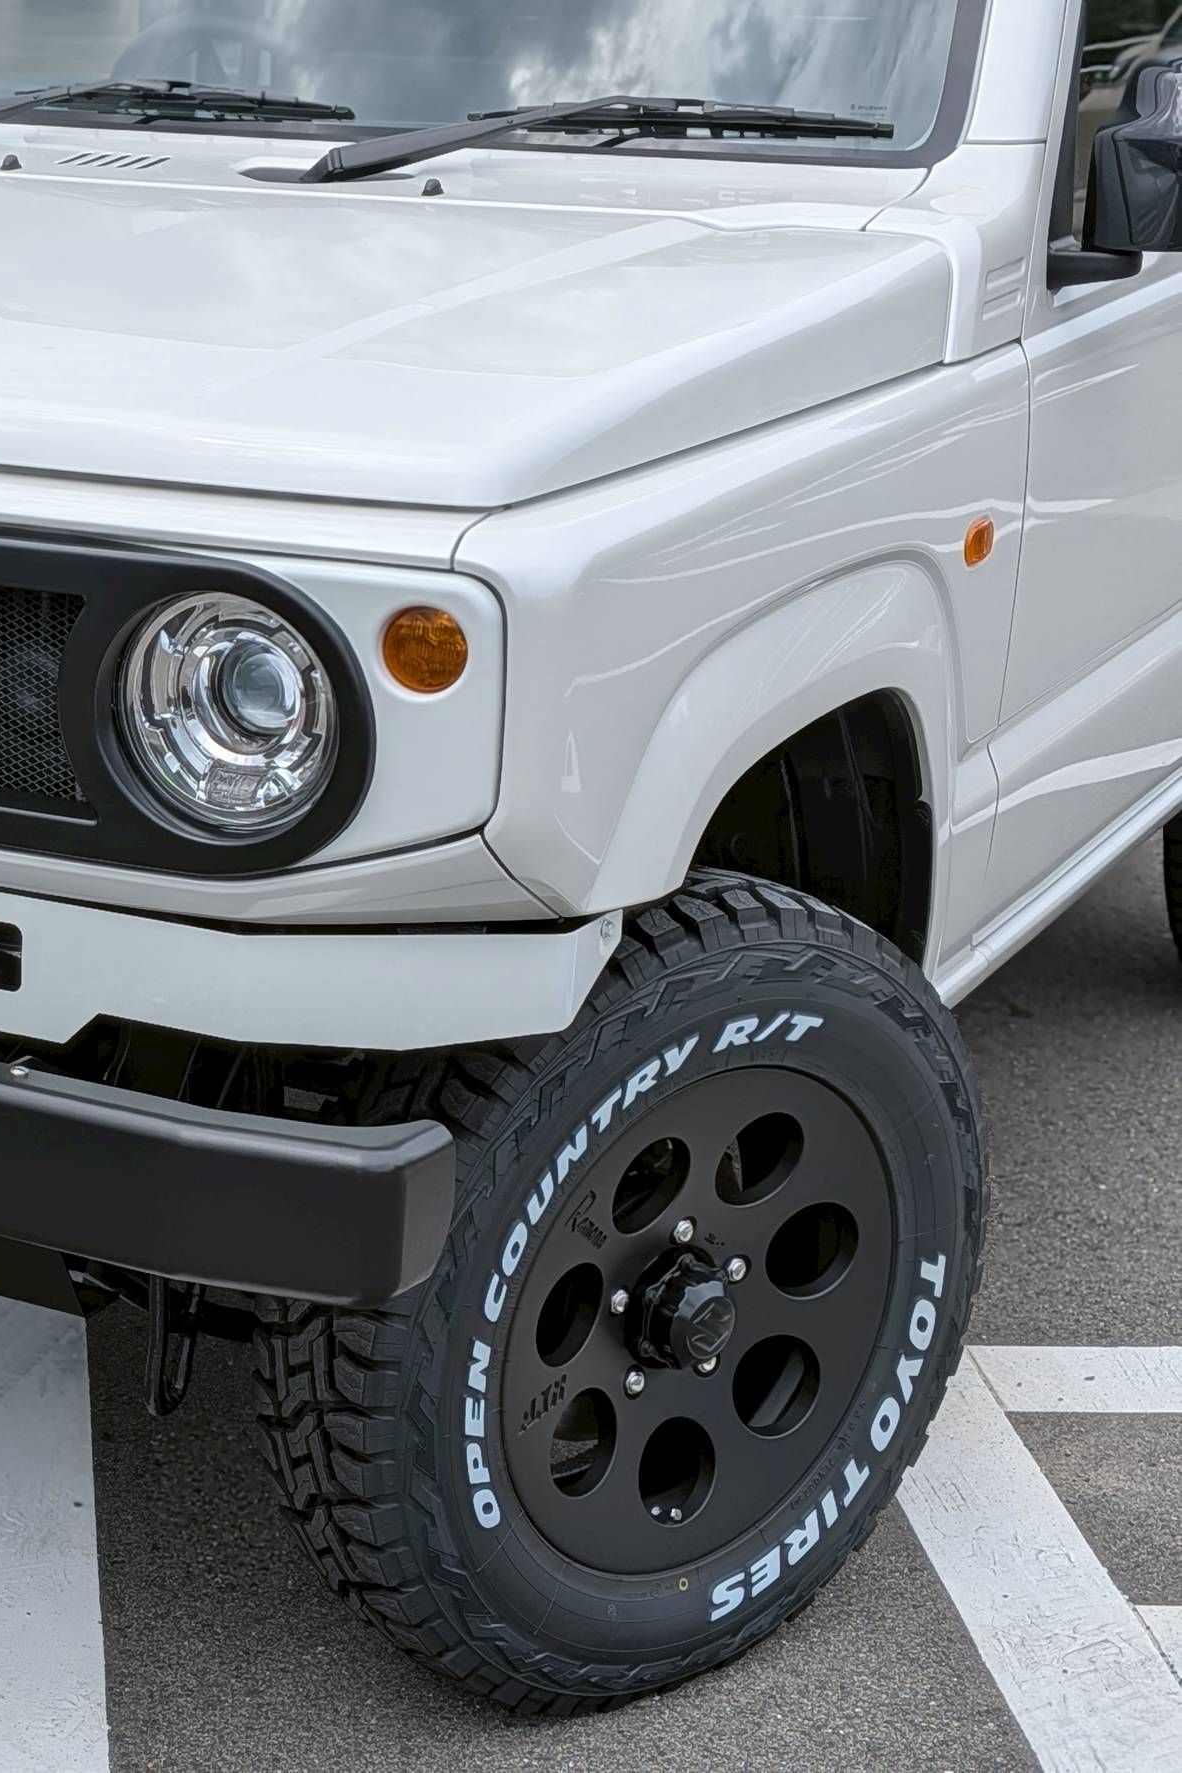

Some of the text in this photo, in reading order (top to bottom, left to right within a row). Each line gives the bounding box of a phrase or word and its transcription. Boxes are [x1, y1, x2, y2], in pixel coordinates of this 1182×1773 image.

[463, 1339, 501, 1529] OPEN
[484, 1034, 700, 1323] COUNTRY
[712, 1011, 824, 1053] R/T
[870, 1252, 947, 1452] TOYO
[709, 1457, 871, 1623] TIRES
